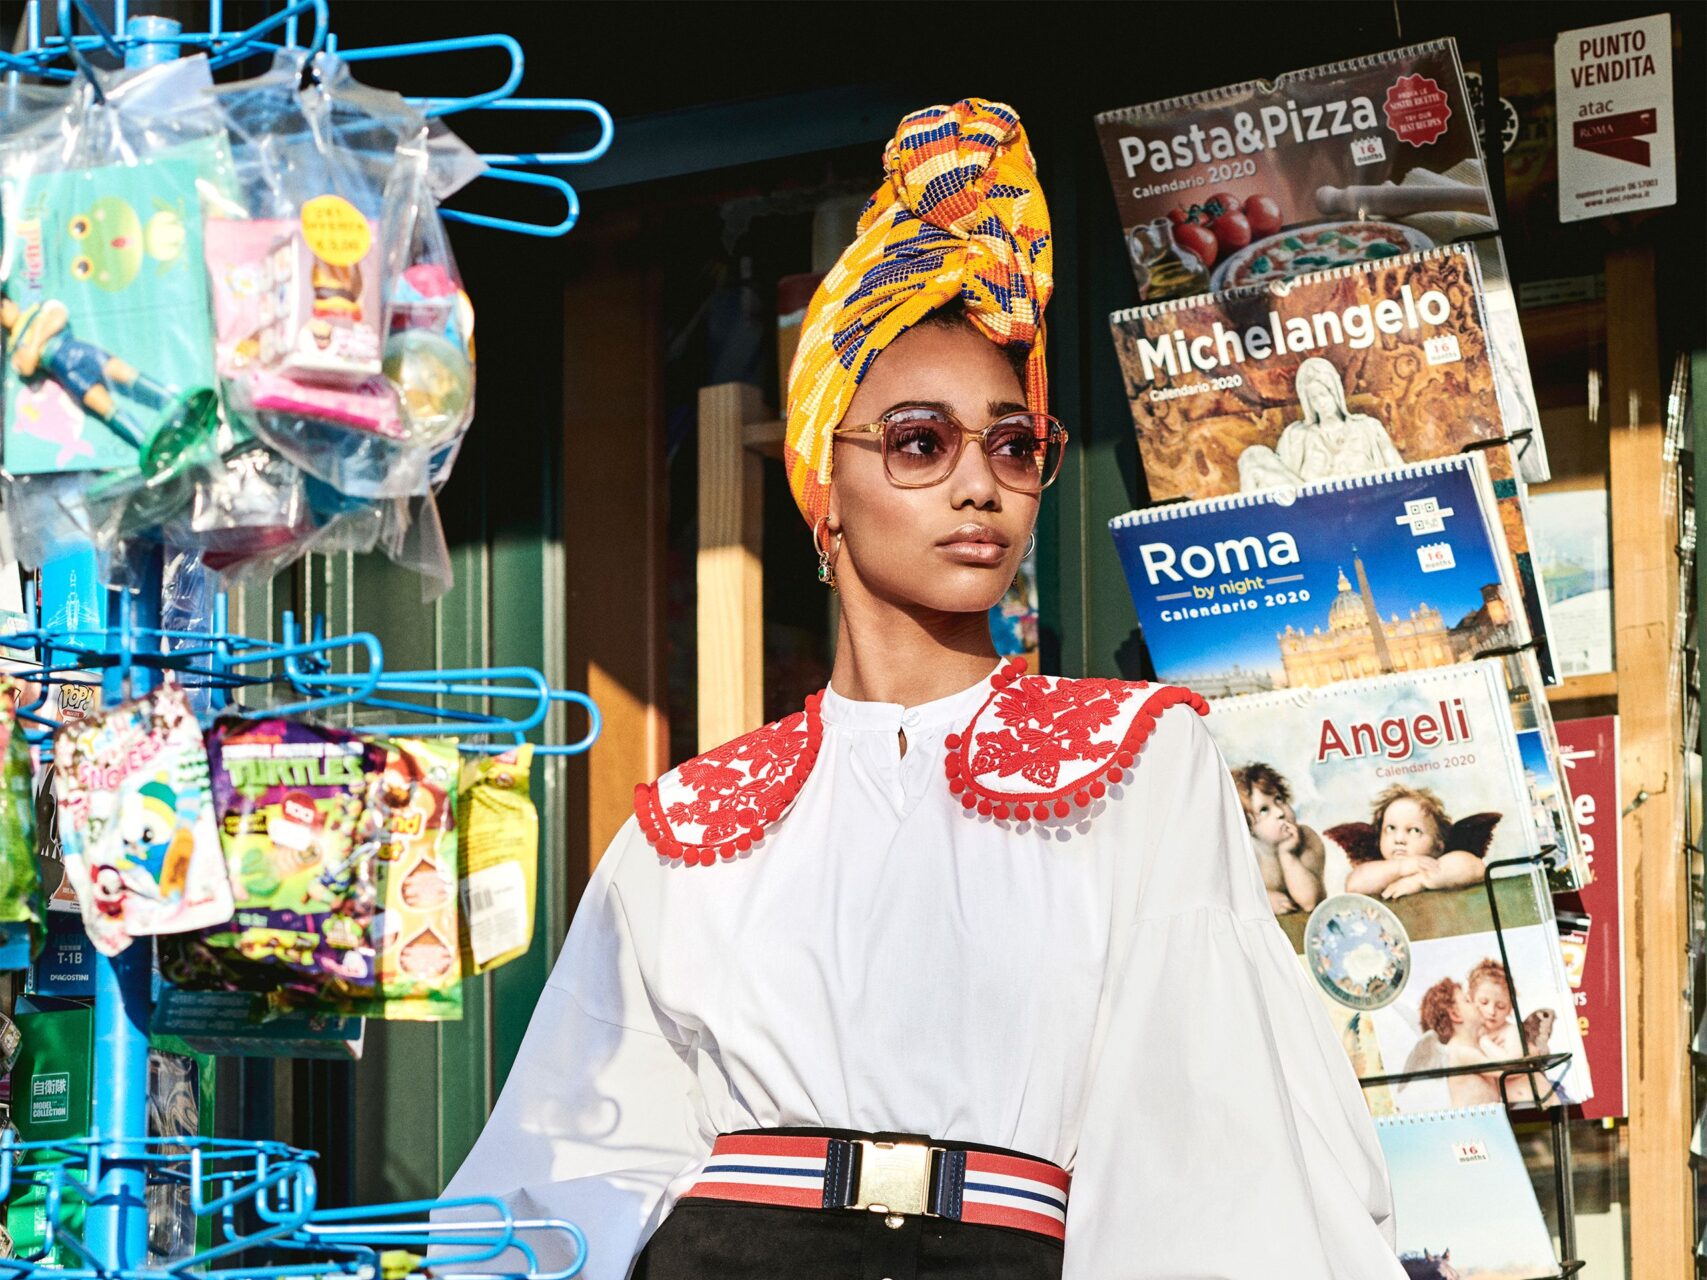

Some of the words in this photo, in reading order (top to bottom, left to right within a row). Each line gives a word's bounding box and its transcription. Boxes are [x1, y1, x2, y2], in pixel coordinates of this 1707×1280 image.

[1579, 29, 1646, 61] PUNTO
[1571, 54, 1656, 89] VENDITA
[1578, 100, 1614, 118] atac
[1118, 96, 1378, 178] Pasta&Pizza
[1579, 123, 1615, 139] ROMA
[1357, 152, 1384, 164] months
[1359, 143, 1377, 155] 16
[1132, 174, 1205, 199] Calendario
[1207, 158, 1257, 184] 2020
[1136, 284, 1451, 380] Michelangelo
[1433, 341, 1450, 354] 16
[1149, 382, 1209, 402] Calendario
[1211, 374, 1243, 392] 2020
[1139, 531, 1301, 586] Roma
[1427, 551, 1445, 563] 16
[1192, 584, 1216, 600] by
[1219, 576, 1266, 597] night
[1160, 599, 1258, 623] Calendario
[1264, 588, 1311, 608] 2020
[1316, 697, 1472, 761] Angeli
[223, 755, 365, 787] TURTLES
[1375, 759, 1441, 779] Calendario
[1443, 753, 1477, 769] 2020
[57, 952, 83, 965] T-1B
[32, 1108, 66, 1118] COLLECTION
[33, 1101, 52, 1110] MODEL
[1462, 1146, 1478, 1156] 16
